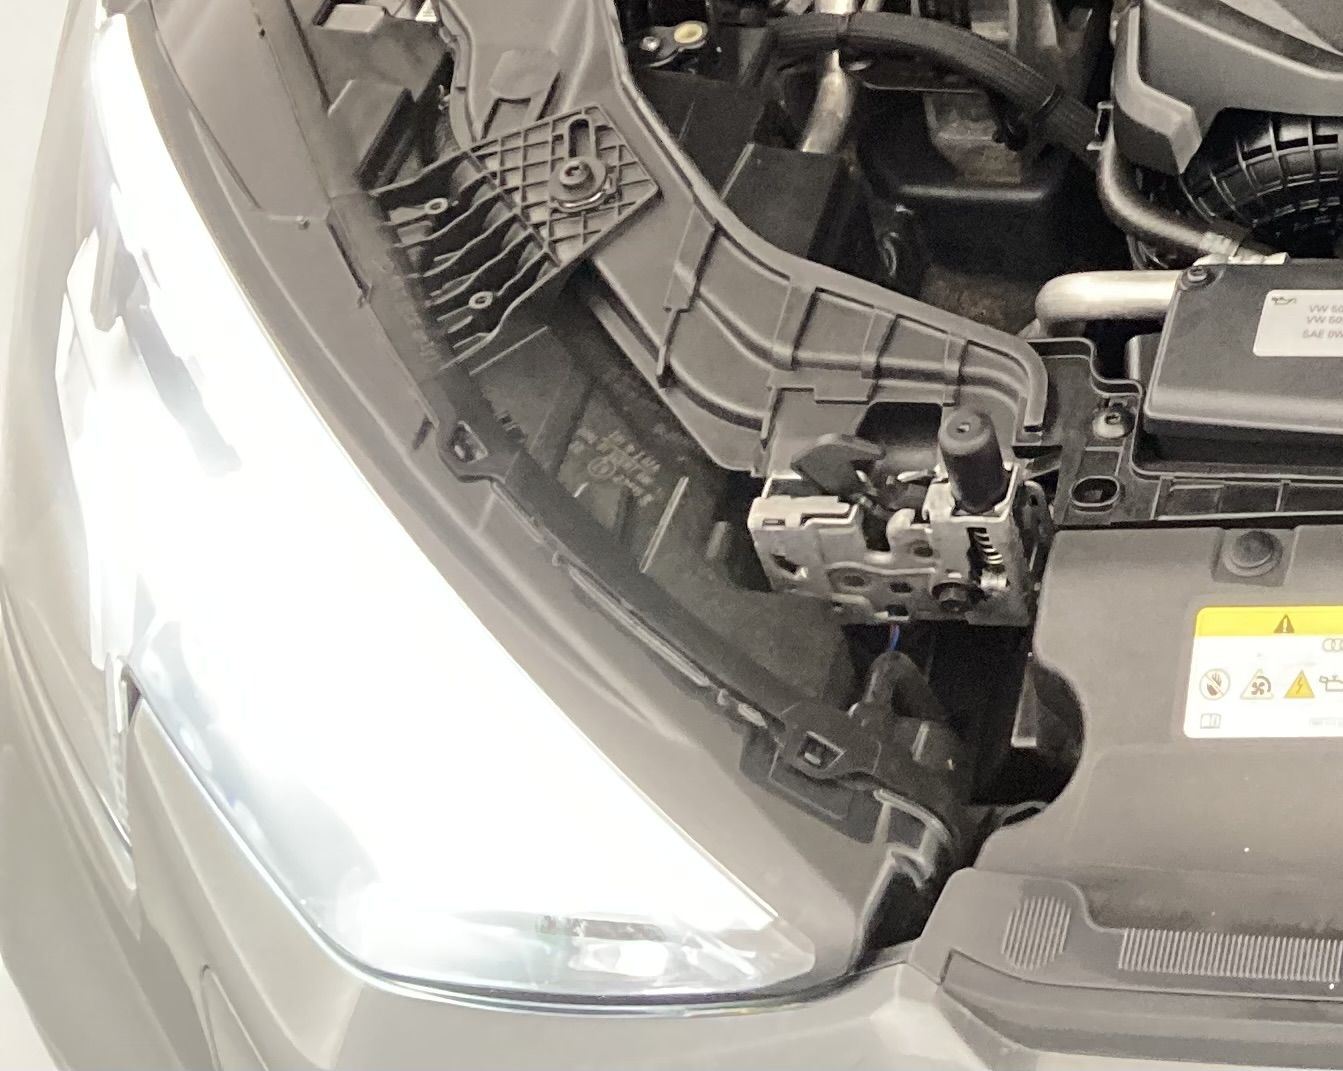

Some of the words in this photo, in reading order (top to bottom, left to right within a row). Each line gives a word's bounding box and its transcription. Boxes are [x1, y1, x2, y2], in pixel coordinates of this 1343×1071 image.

[1309, 305, 1328, 313] VW
[1307, 316, 1326, 324] VW
[1302, 330, 1324, 338] SAE
